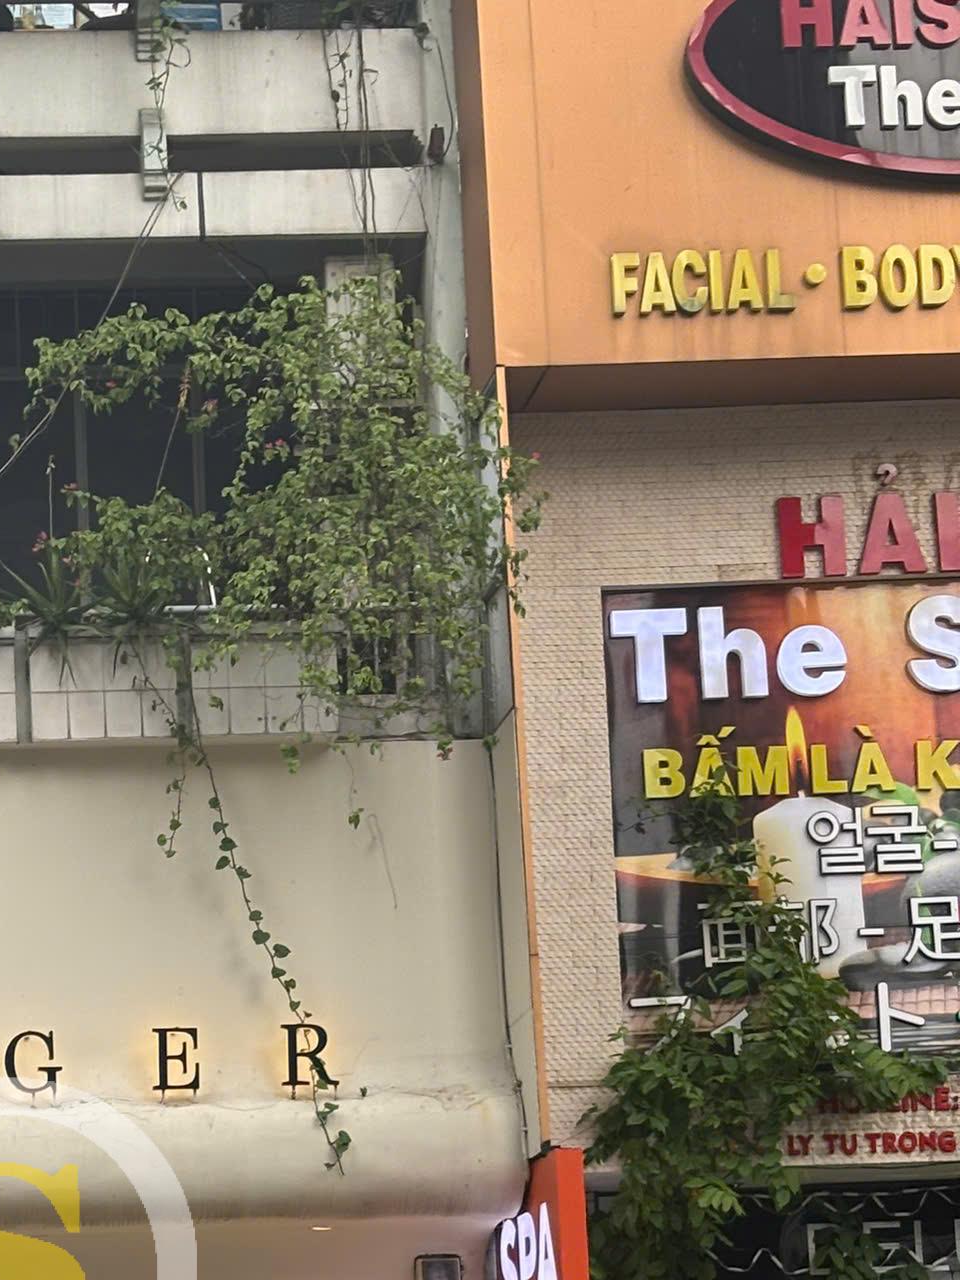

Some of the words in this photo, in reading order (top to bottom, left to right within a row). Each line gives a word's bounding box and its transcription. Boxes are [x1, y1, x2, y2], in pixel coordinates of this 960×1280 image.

[827, 64, 960, 130] The
[610, 248, 796, 316] FACIAL
[609, 606, 848, 704] The
[814, 724, 897, 794] LÀ
[822, 1133, 858, 1155] TU
[864, 1131, 957, 1154] TRONG
